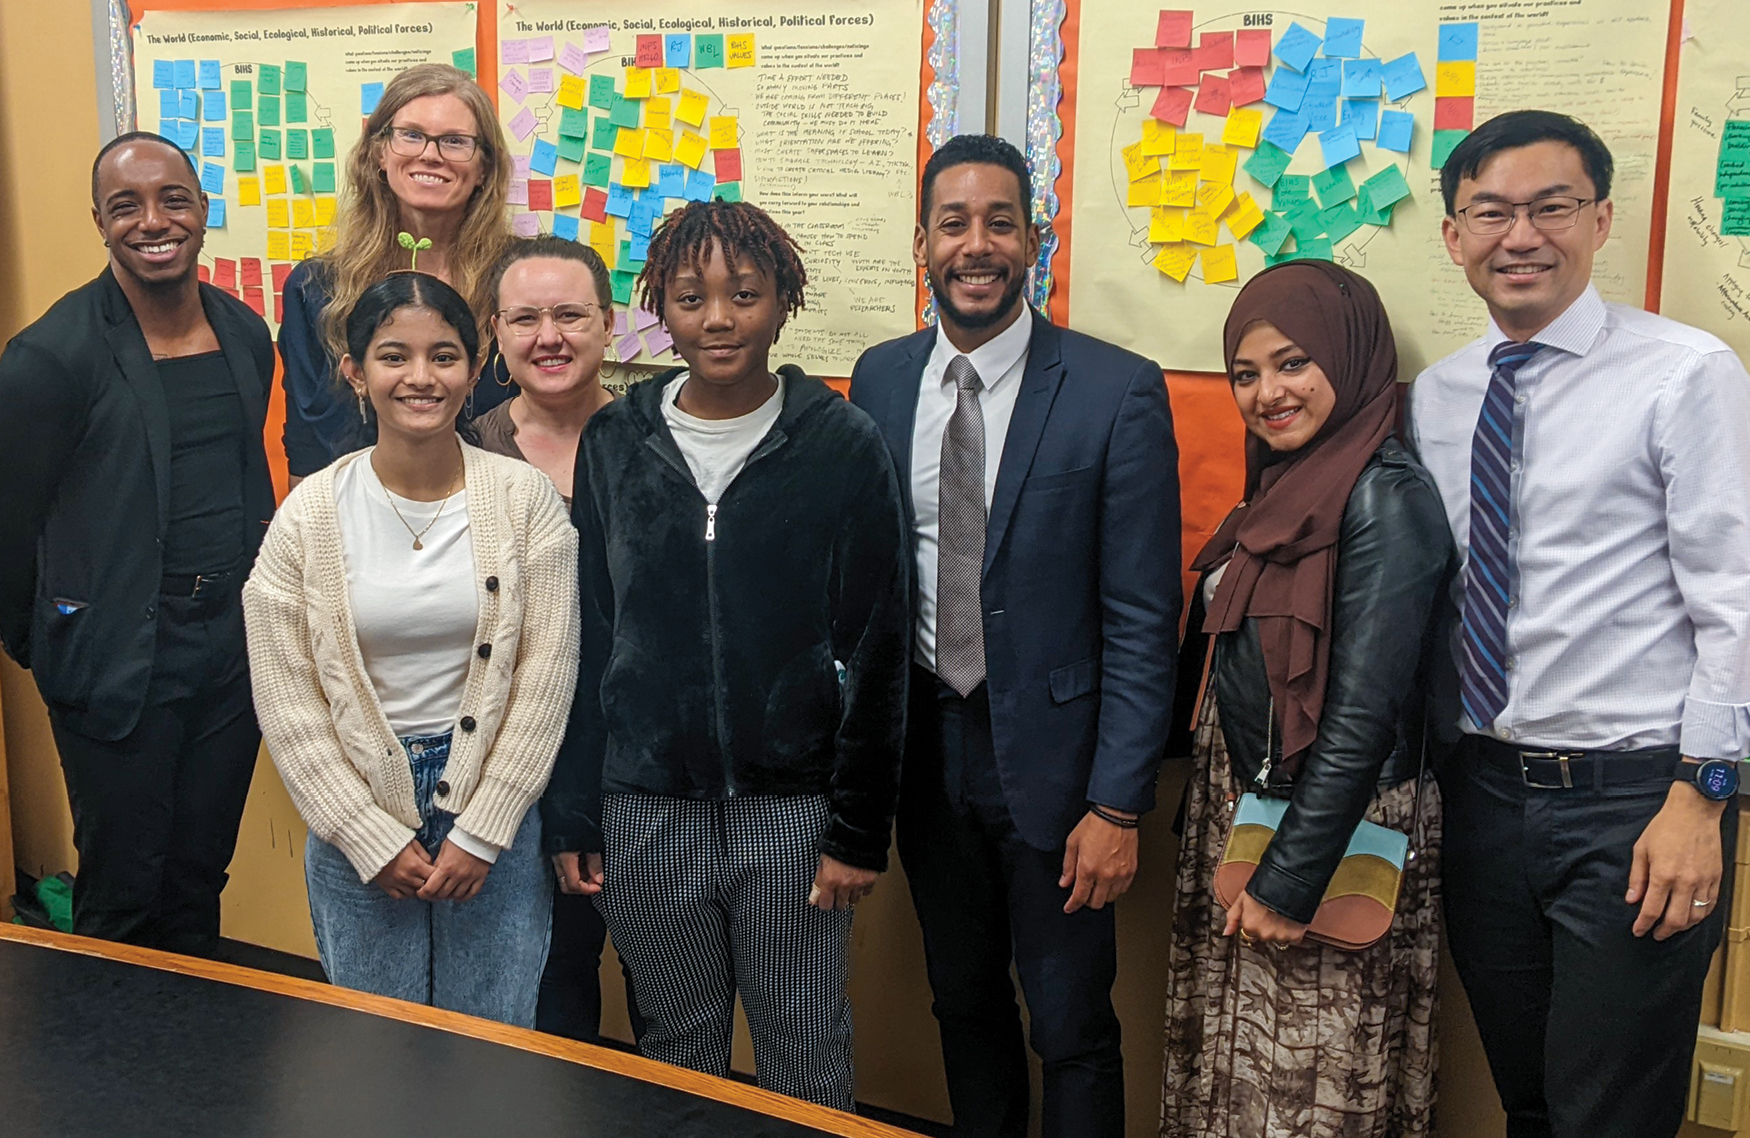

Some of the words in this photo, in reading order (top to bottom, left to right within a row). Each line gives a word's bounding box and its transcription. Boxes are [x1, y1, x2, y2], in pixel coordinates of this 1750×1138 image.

[516, 21, 533, 32] The
[536, 20, 564, 32] World
[624, 18, 657, 31] Social,
[659, 17, 716, 32] Ecological,
[719, 15, 777, 29] Historical,
[780, 14, 826, 27] Political
[1243, 13, 1274, 27] BIHS
[147, 35, 161, 44] The
[163, 33, 186, 44] World
[188, 32, 233, 44] (Economic,
[234, 30, 262, 41] Social,
[264, 28, 310, 42] Ecological,
[311, 25, 356, 38] Historical,
[358, 24, 393, 36] Political
[671, 41, 683, 52] RJ
[699, 44, 720, 58] WBL
[729, 51, 753, 61] VALUES
[621, 57, 637, 68] BIH
[234, 64, 253, 75] BIHS
[757, 73, 777, 82] TIME
[786, 74, 814, 83] EFFORT
[816, 73, 849, 82] NEEDED
[822, 83, 849, 91] PARTS
[801, 112, 823, 120] SKILLS
[866, 110, 888, 118] BUILD
[803, 129, 835, 137] MEANING
[807, 222, 845, 230] CLASSROOM
[799, 344, 843, 355] APOLOGIZE
[602, 382, 629, 392] rces)
